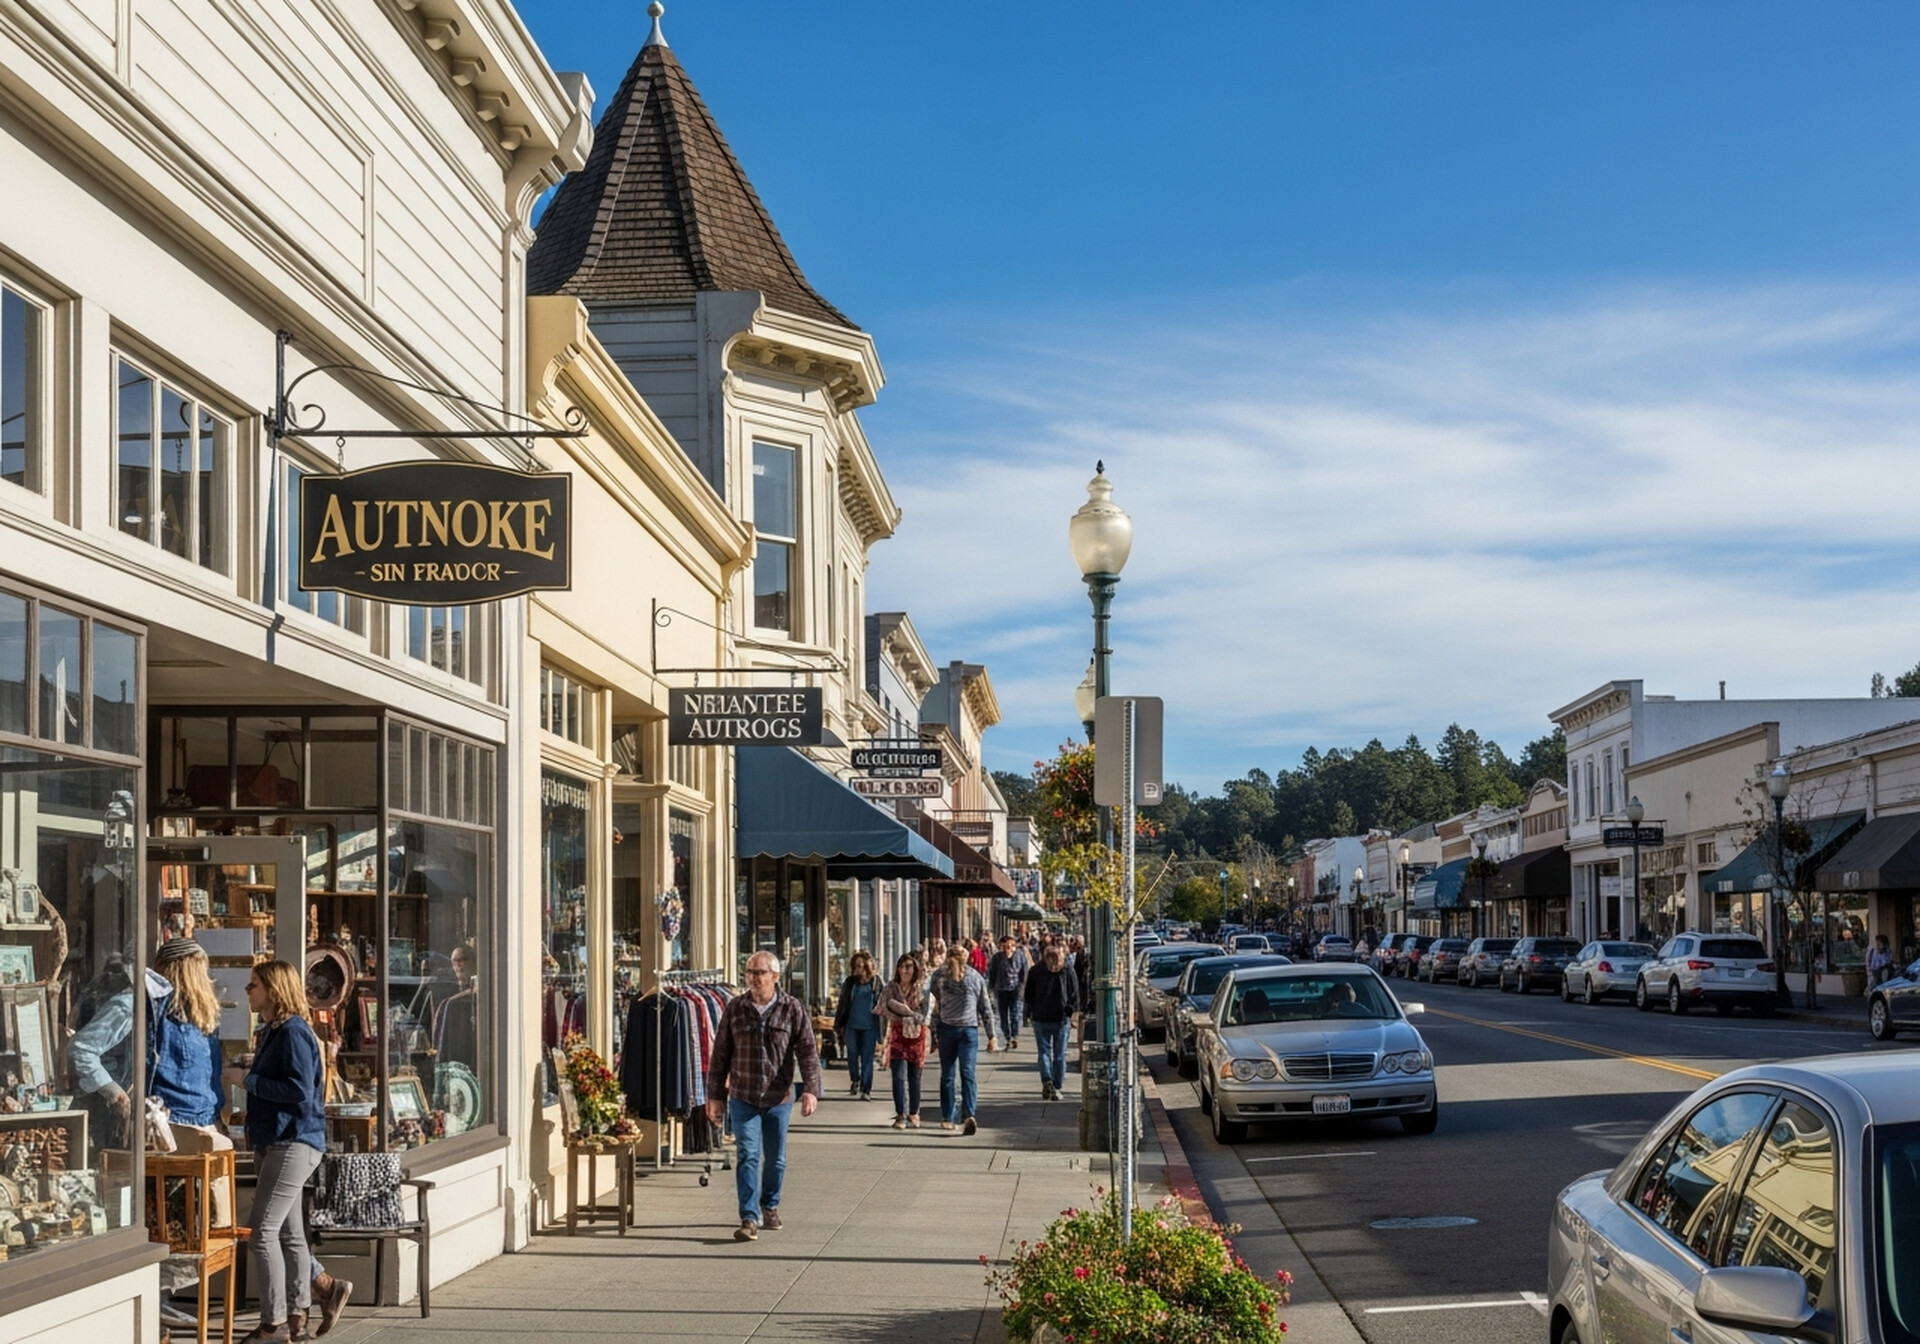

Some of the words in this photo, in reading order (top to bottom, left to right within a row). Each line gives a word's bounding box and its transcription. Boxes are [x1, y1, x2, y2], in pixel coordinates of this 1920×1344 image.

[310, 493, 555, 563] AUTNOKE
[370, 563, 405, 582] SIN
[688, 718, 802, 739] AUTROGS
